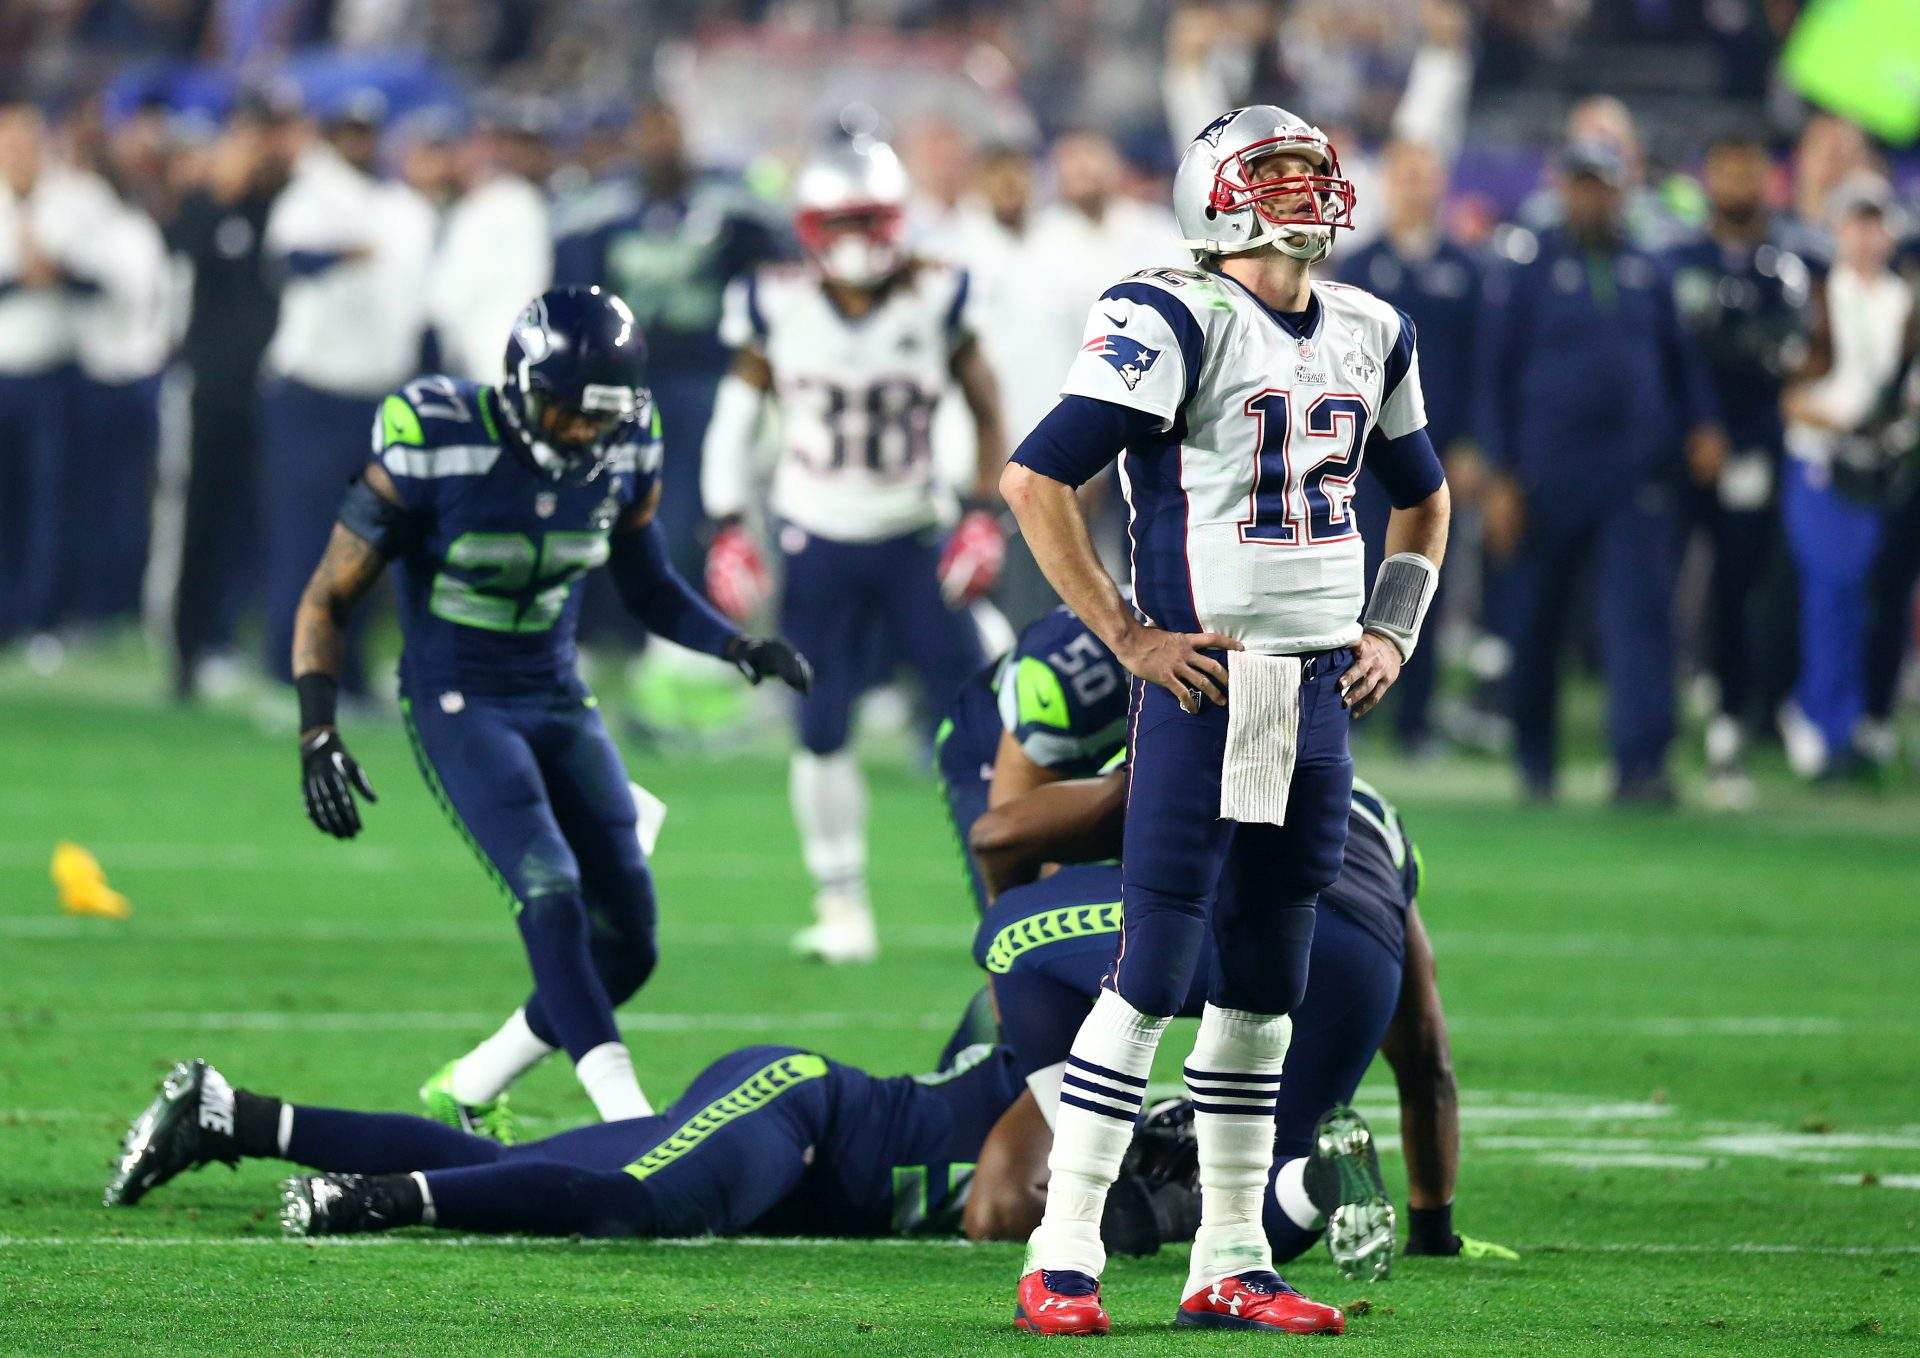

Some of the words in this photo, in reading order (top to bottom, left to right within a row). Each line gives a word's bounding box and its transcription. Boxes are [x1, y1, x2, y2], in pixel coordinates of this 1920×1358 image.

[403, 374, 472, 423] 27
[789, 374, 937, 484] 38
[1237, 388, 1372, 546] 12
[429, 530, 611, 635] 27
[1048, 633, 1118, 707] 50
